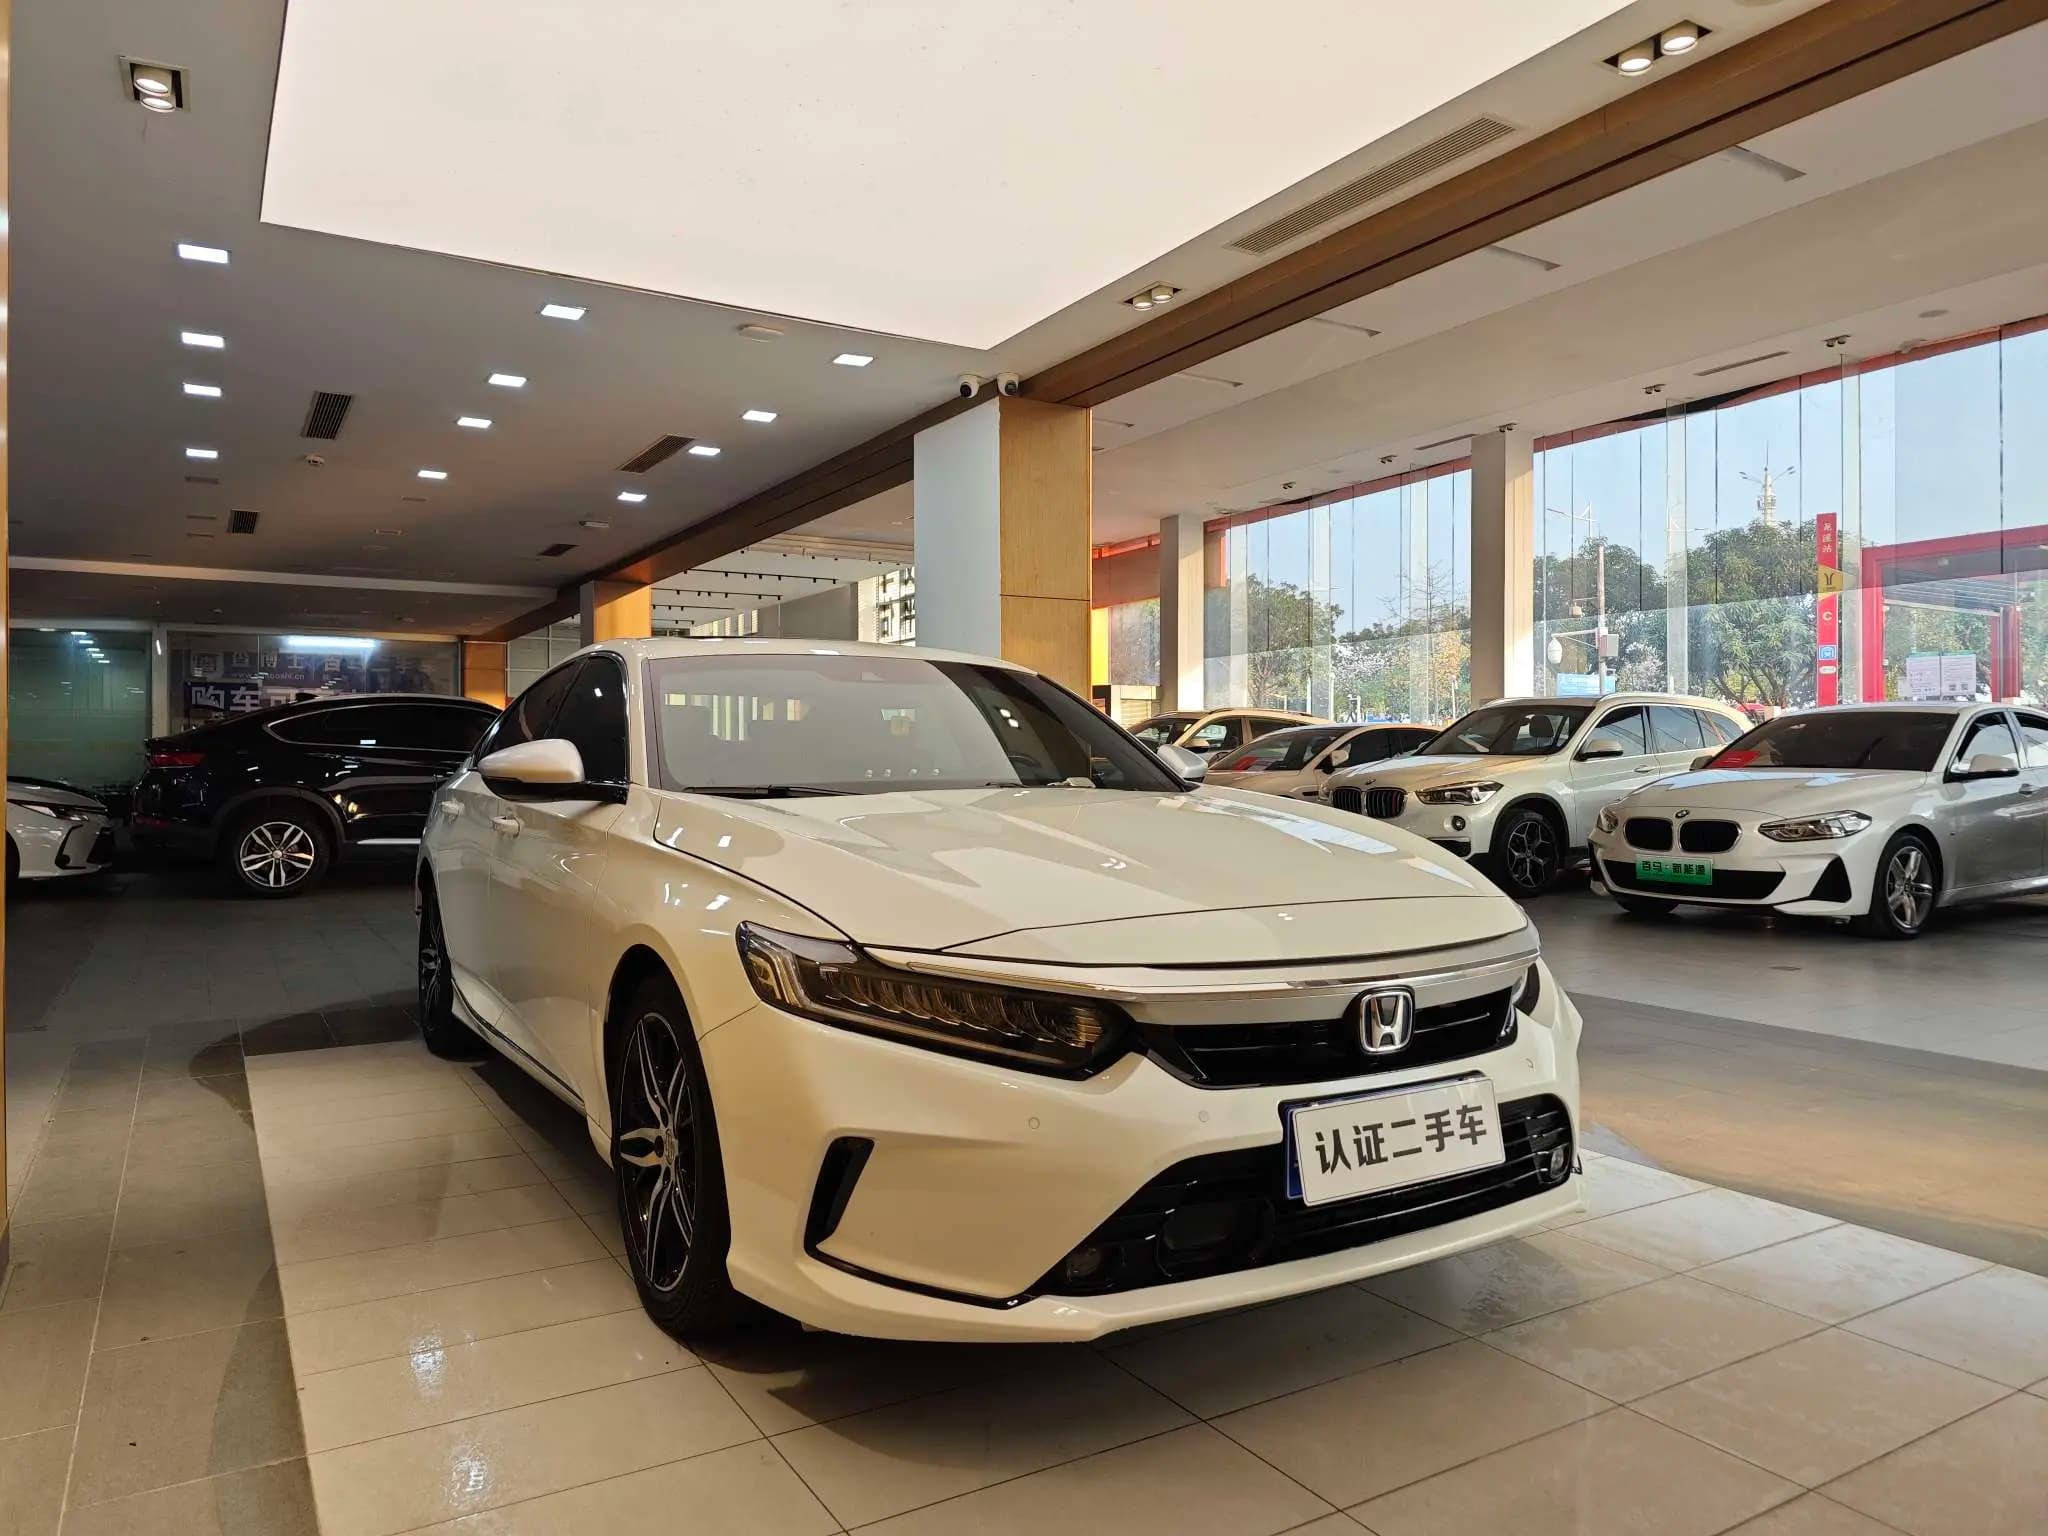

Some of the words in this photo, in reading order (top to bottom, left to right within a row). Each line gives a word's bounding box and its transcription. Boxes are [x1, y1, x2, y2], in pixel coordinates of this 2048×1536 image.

[1315, 1105, 1487, 1175] 认证二手车
